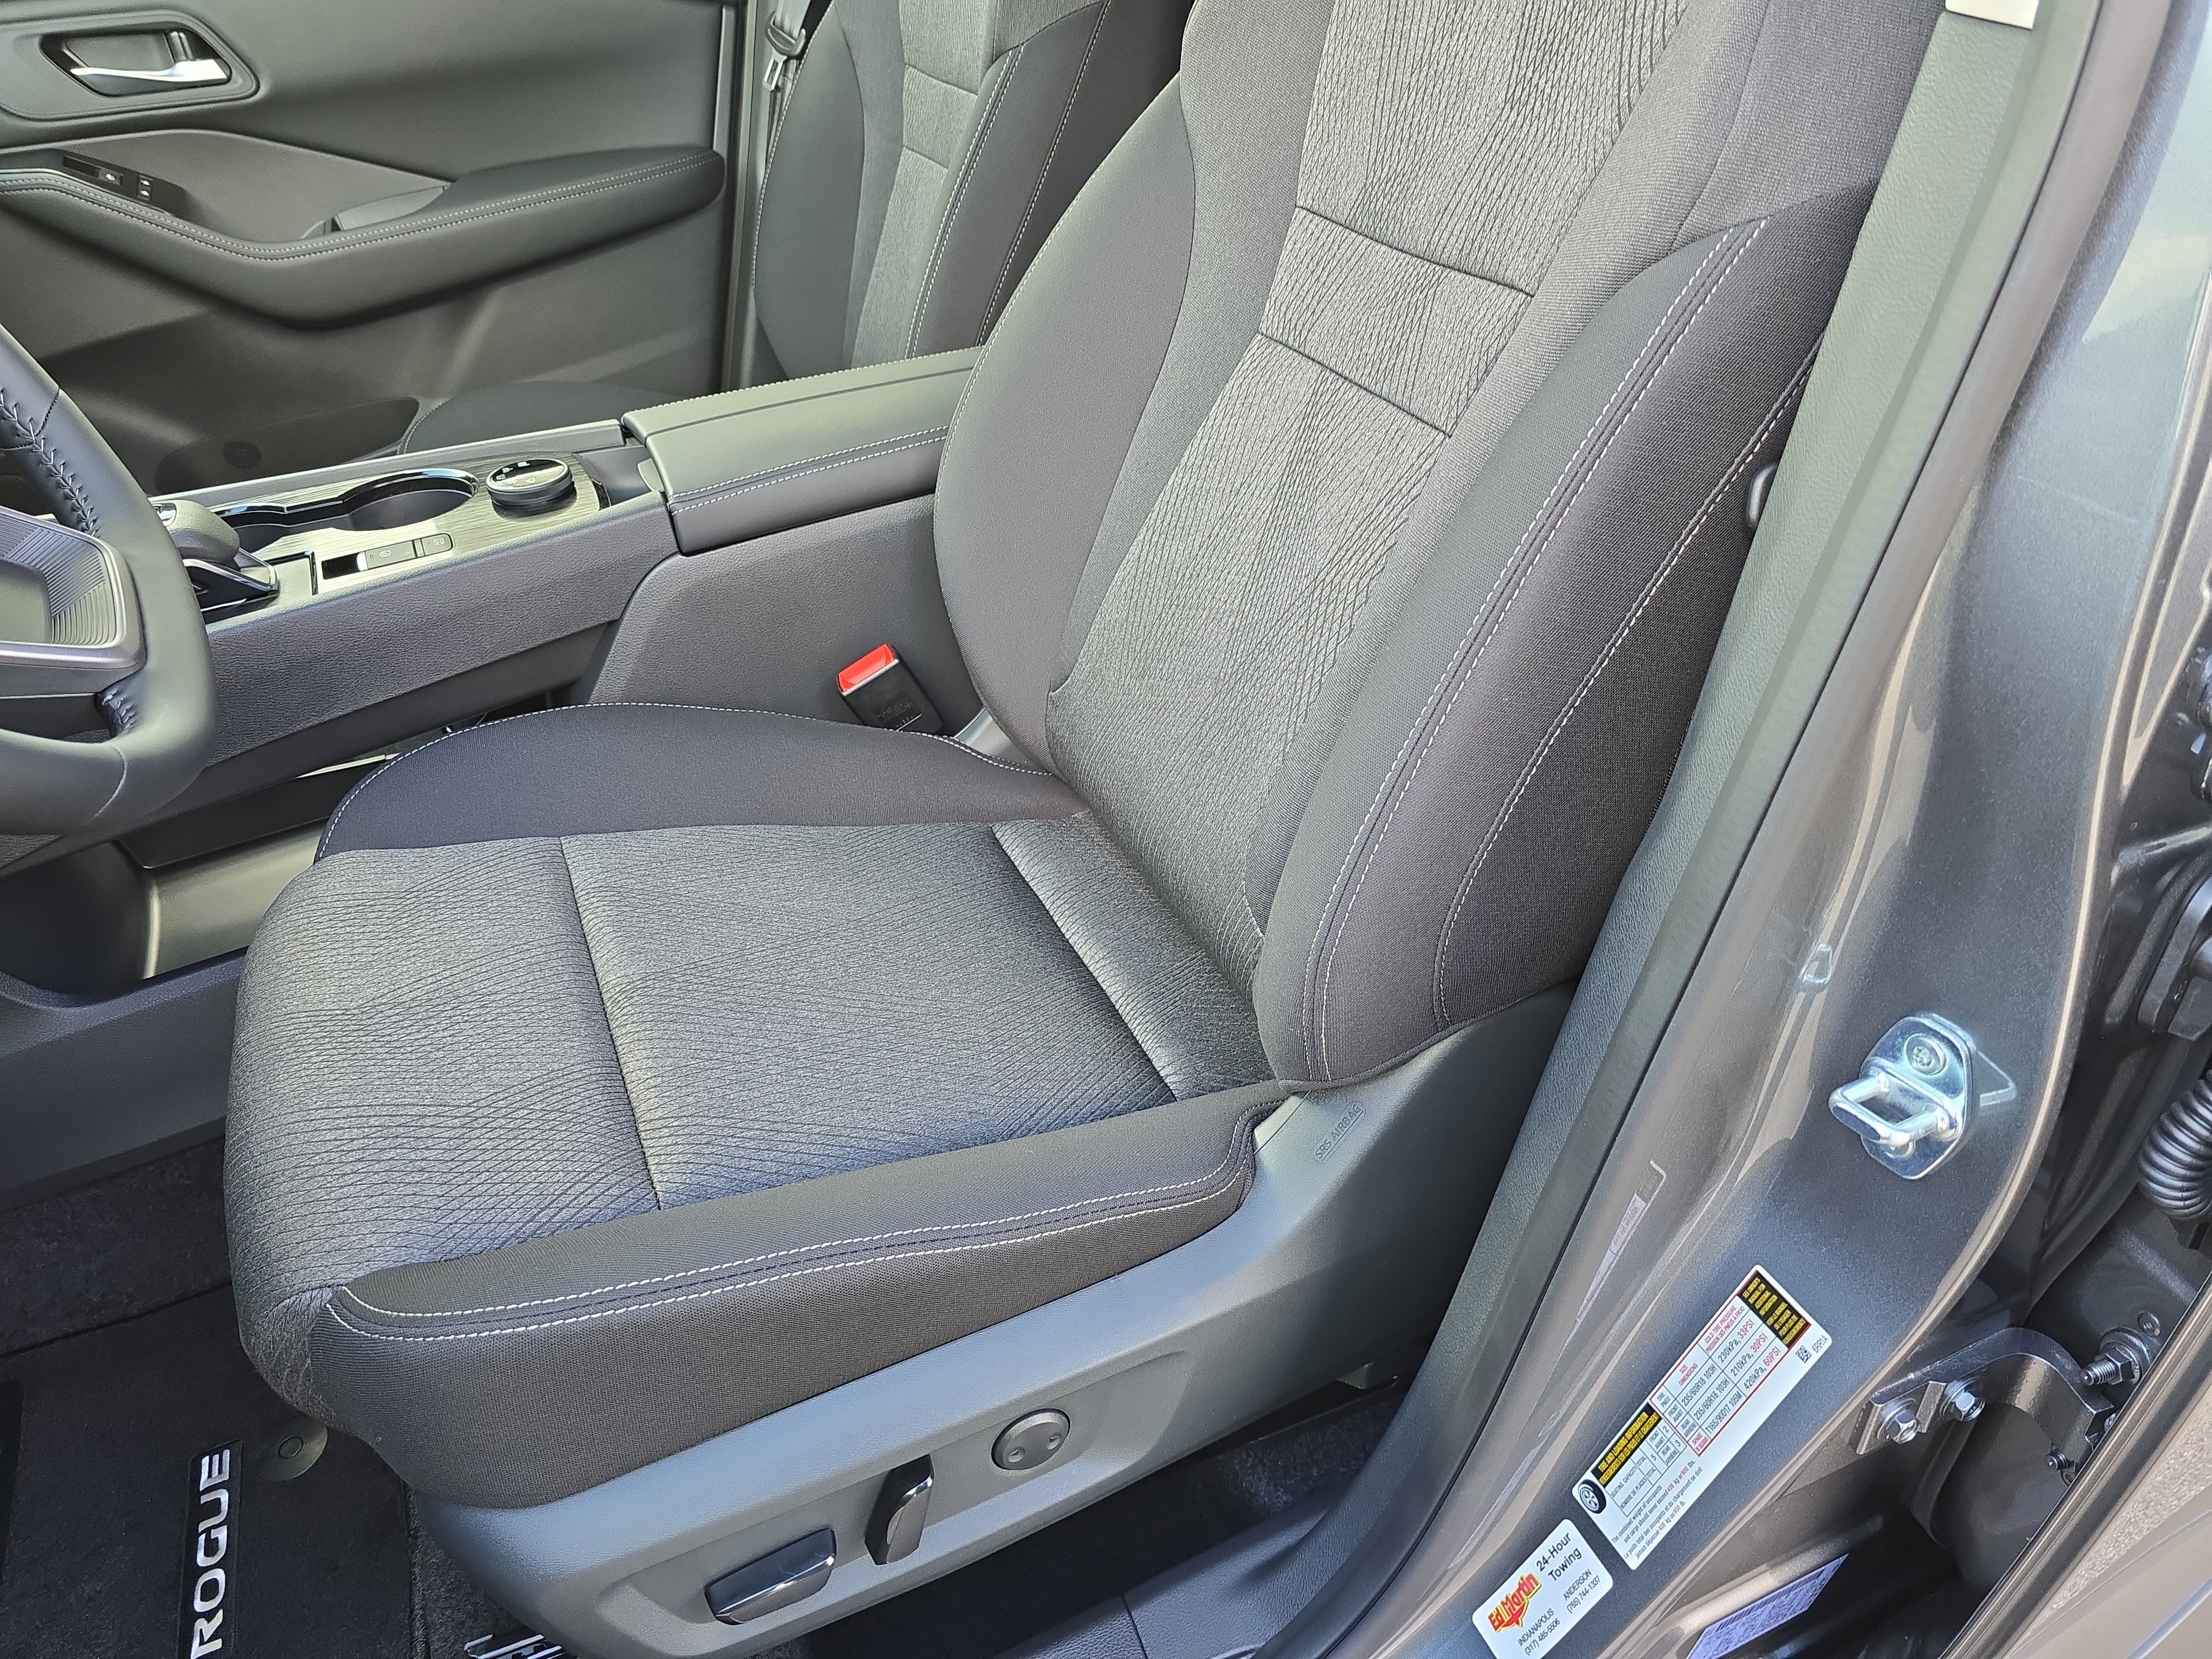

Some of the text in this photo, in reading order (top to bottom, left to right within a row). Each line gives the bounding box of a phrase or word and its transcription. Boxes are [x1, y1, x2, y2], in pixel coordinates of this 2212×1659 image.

[1315, 1102, 1363, 1159] SRS AIRBAG
[1717, 1339, 1741, 1363] 230kPa,
[1737, 1318, 1754, 1339] 33PSI
[1730, 1352, 1754, 1377] 210kPa,
[1750, 1332, 1767, 1353] 30PSI
[1681, 1363, 1717, 1406] 235/60R18 103H
[1743, 1346, 1780, 1389] 420kPa, 60PSI
[1693, 1390, 1719, 1420] 235/60R18
[1715, 1377, 1730, 1393] 103H
[1662, 1425, 1669, 1433] 2
[1674, 1439, 1681, 1447] 3
[191, 1449, 230, 1659] ROGUE
[1536, 1532, 1571, 1572] 24-Hour
[1547, 1547, 1581, 1581] Towing
[1487, 1573, 1540, 1632] Ed Martin
[1563, 1568, 1592, 1601] ANDERSON
[1566, 1574, 1600, 1613] (765) 744-1337
[1517, 1607, 1554, 1646] INDIANAPOLIS
[1524, 1638, 1539, 1656] (317)
